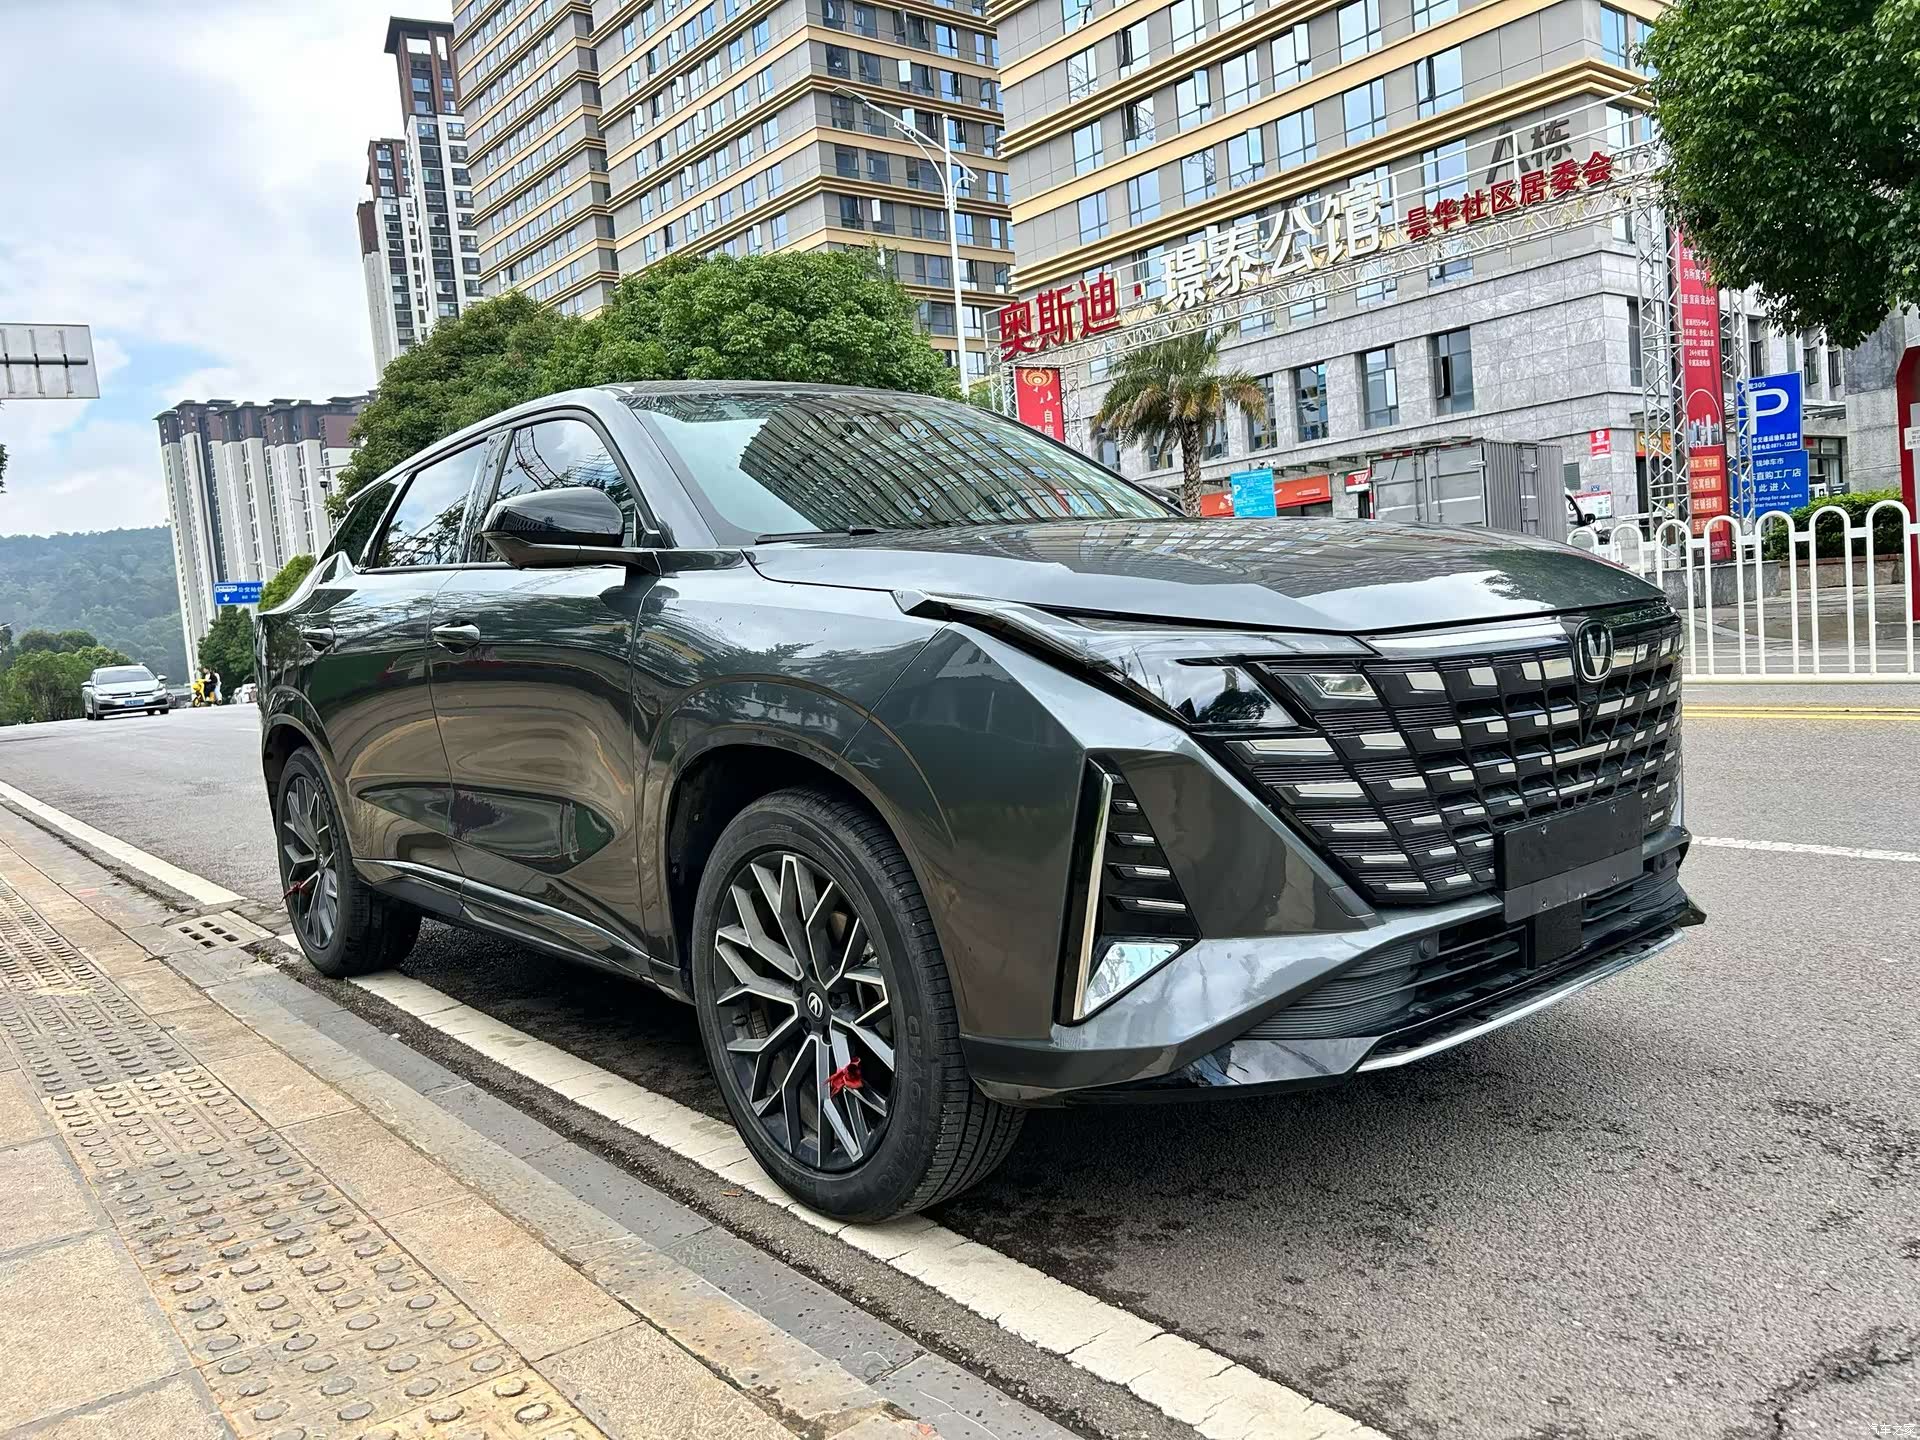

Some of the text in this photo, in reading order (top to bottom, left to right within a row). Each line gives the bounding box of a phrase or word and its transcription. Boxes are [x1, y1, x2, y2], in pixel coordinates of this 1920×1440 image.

[1407, 151, 1613, 240] 昙华社区居委会
[1000, 183, 1381, 361] 奥斯迪 璟泰公馆
[1748, 388, 1789, 435] P
